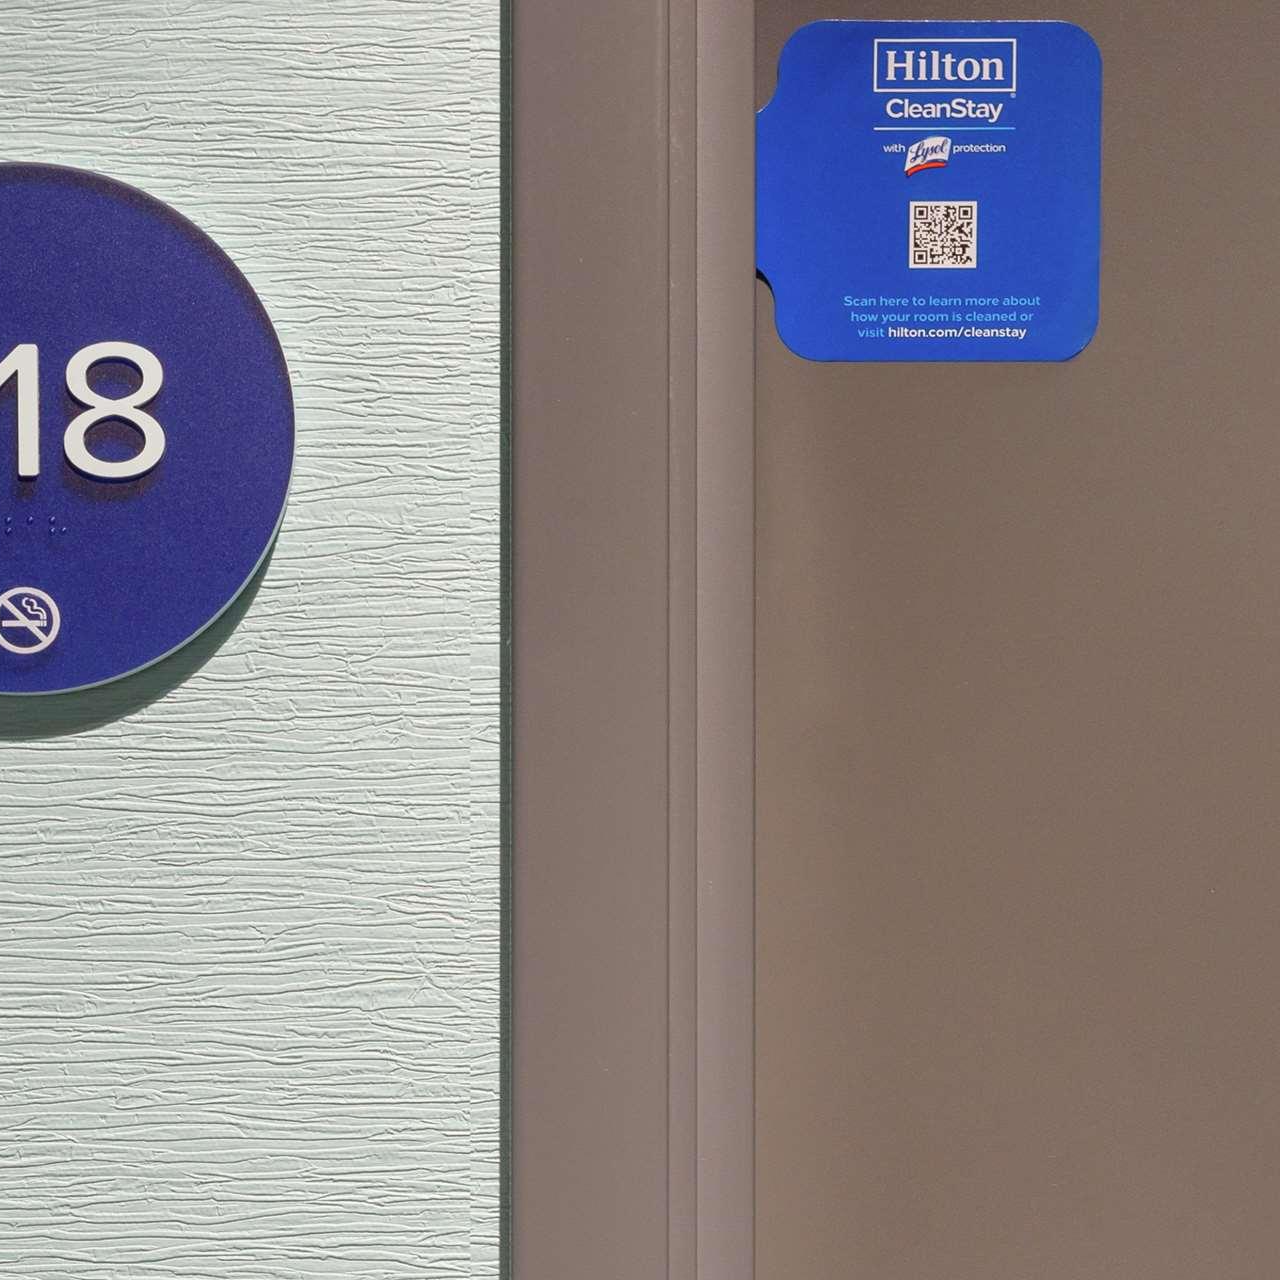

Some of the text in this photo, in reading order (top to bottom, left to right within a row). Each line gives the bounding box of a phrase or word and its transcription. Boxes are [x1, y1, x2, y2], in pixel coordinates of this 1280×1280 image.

[886, 50, 1005, 81] Hilton
[886, 98, 1004, 123] CleanStay
[883, 138, 1006, 163] with Lysol protection
[843, 295, 1041, 306] Scan here to learn more about
[850, 311, 1034, 324] how your room is cleaned or
[857, 326, 1027, 340] visit hilton.com/cleanstay
